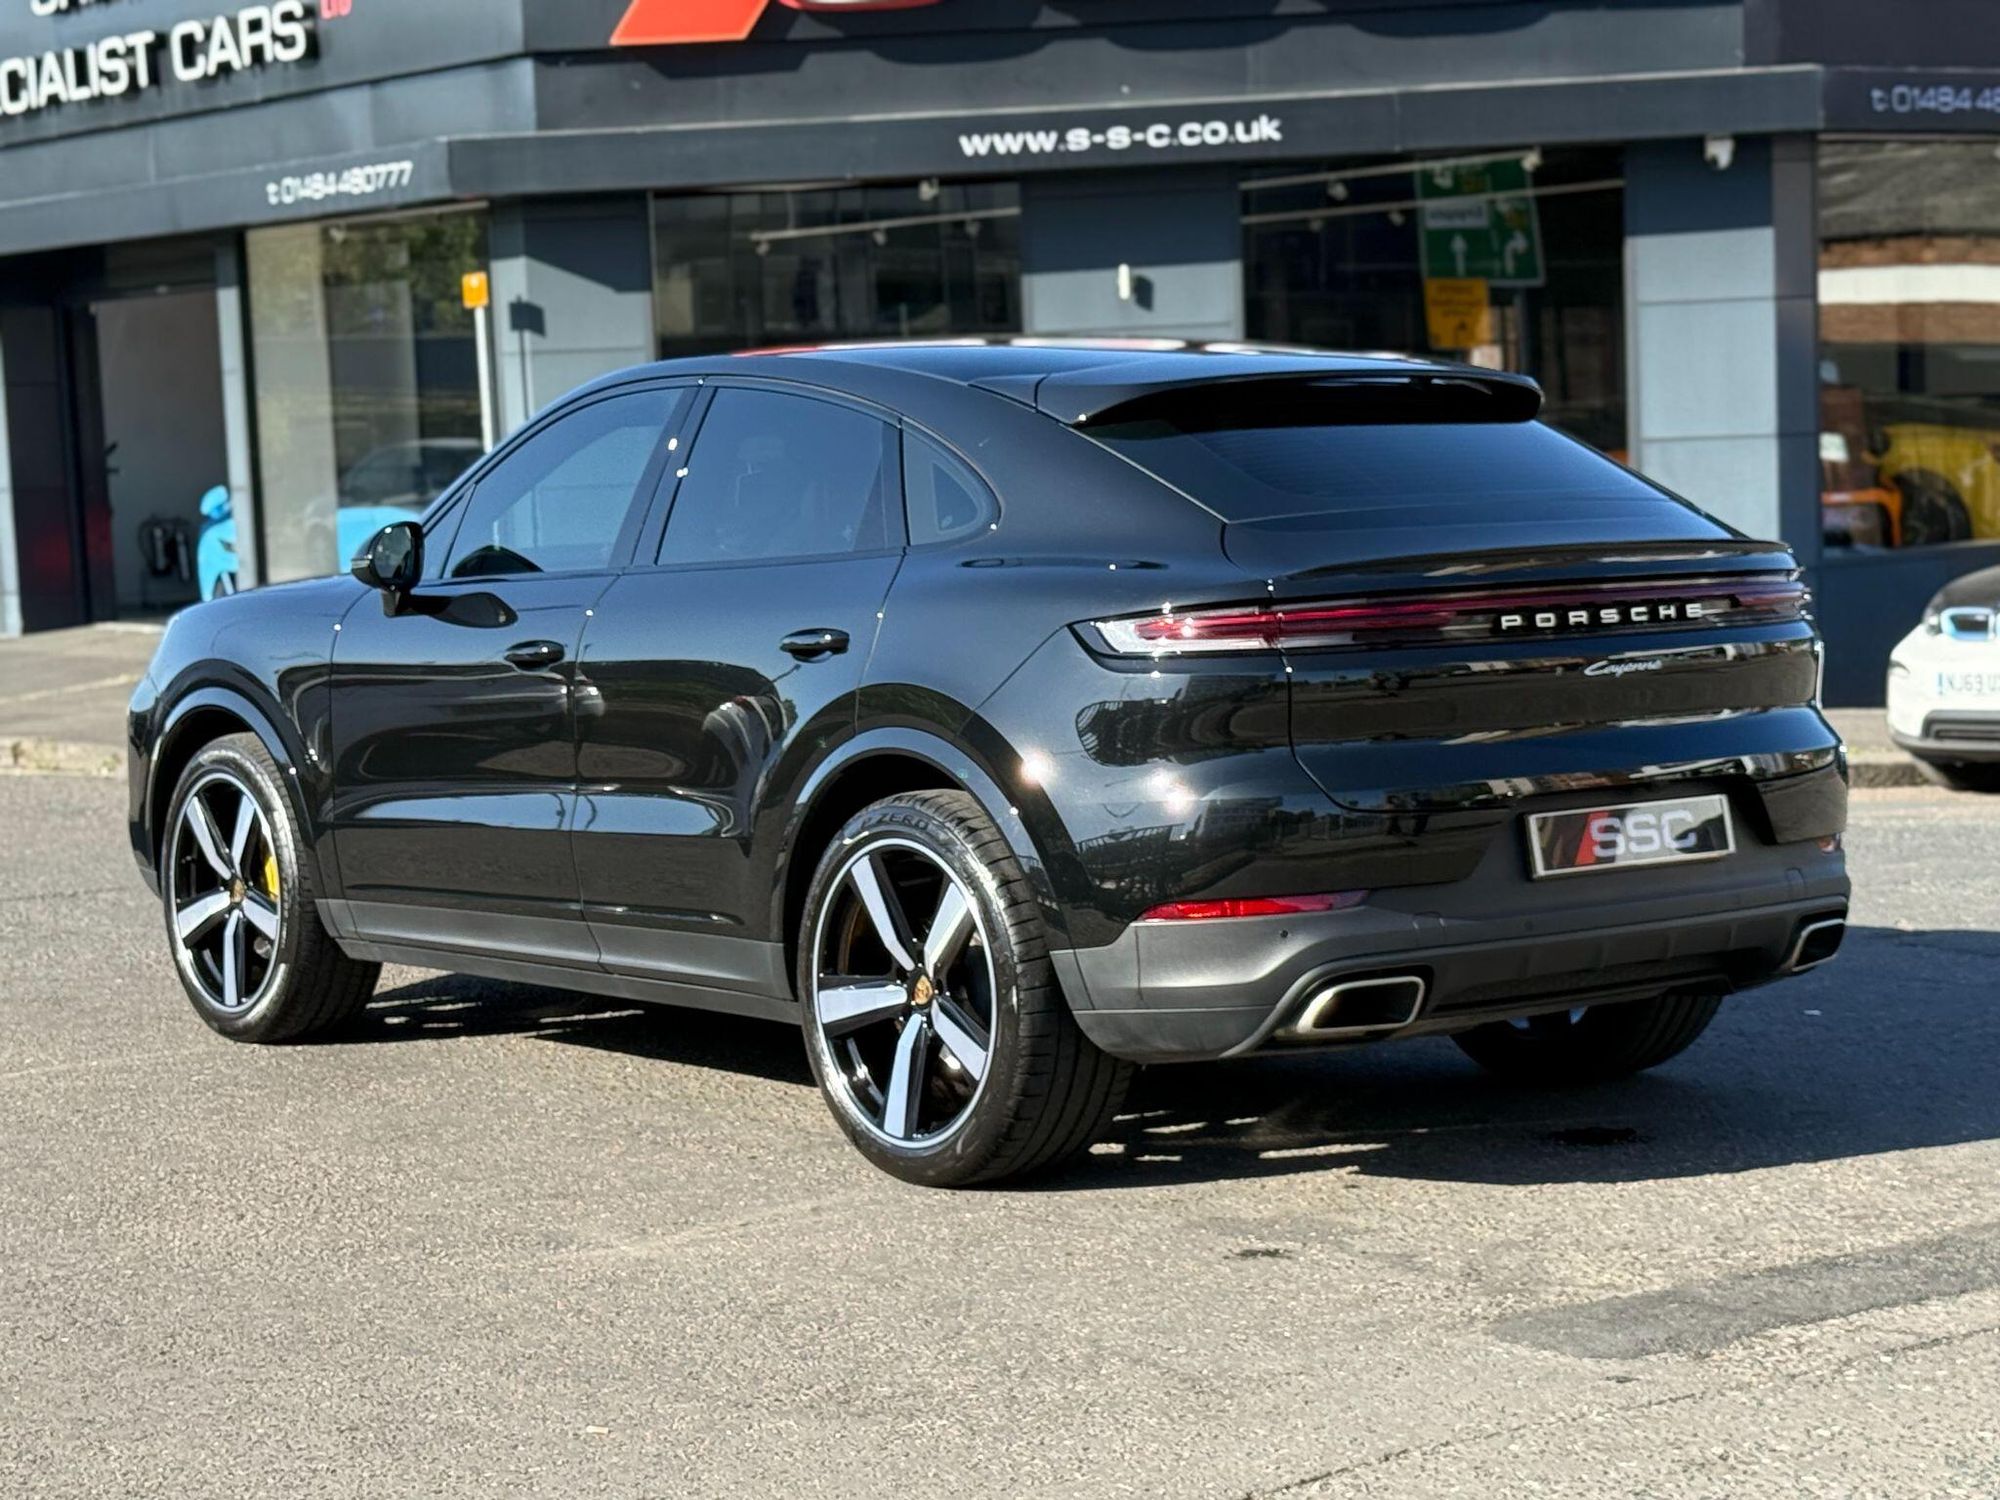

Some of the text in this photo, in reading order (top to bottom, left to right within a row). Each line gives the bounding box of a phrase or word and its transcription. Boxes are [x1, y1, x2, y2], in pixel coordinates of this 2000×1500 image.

[0, 29, 155, 116] CIALIST
[170, 0, 307, 82] CARS
[958, 114, 1283, 158] www.s-s-c.co.uk
[1500, 602, 1702, 631] PORSCHE
[1583, 659, 1663, 679] Cayenne
[1589, 808, 1698, 858] SSC
